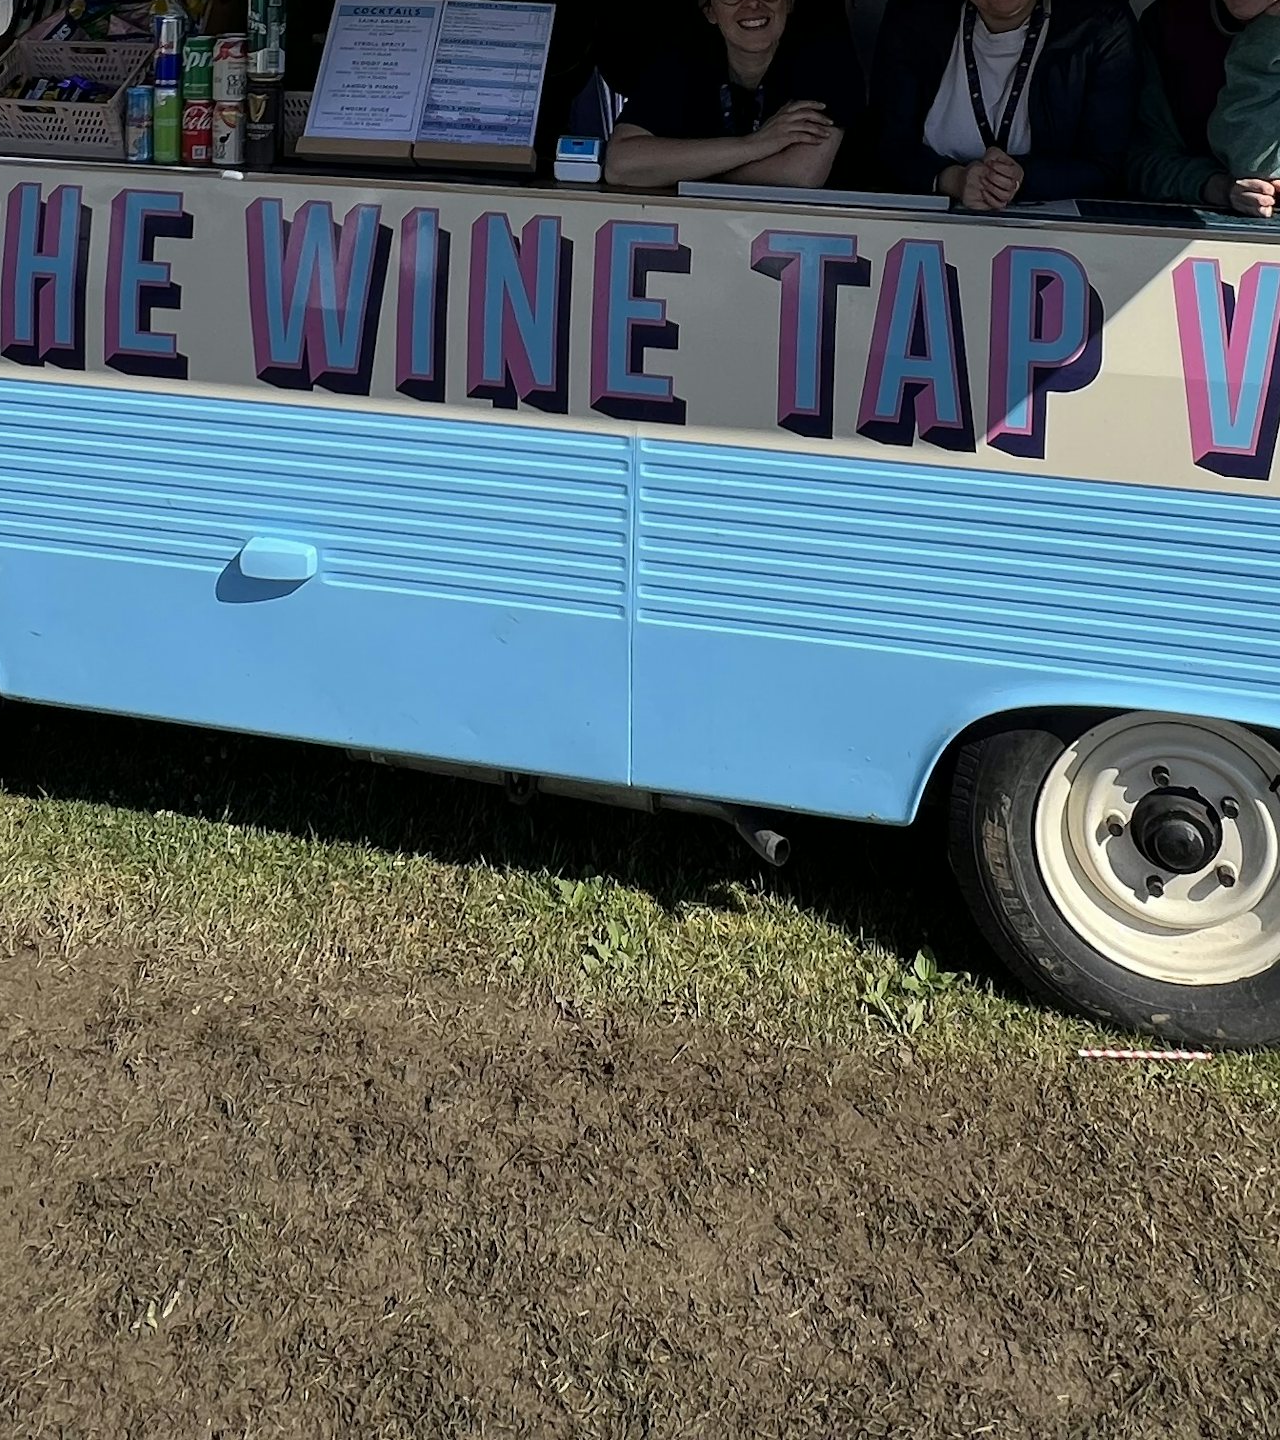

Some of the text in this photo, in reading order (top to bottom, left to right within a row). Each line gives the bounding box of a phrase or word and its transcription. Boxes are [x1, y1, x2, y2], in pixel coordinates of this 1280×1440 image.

[353, 7, 422, 16] COCKTAILS
[245, 196, 692, 426] WINE
[750, 228, 1106, 460] TAP
